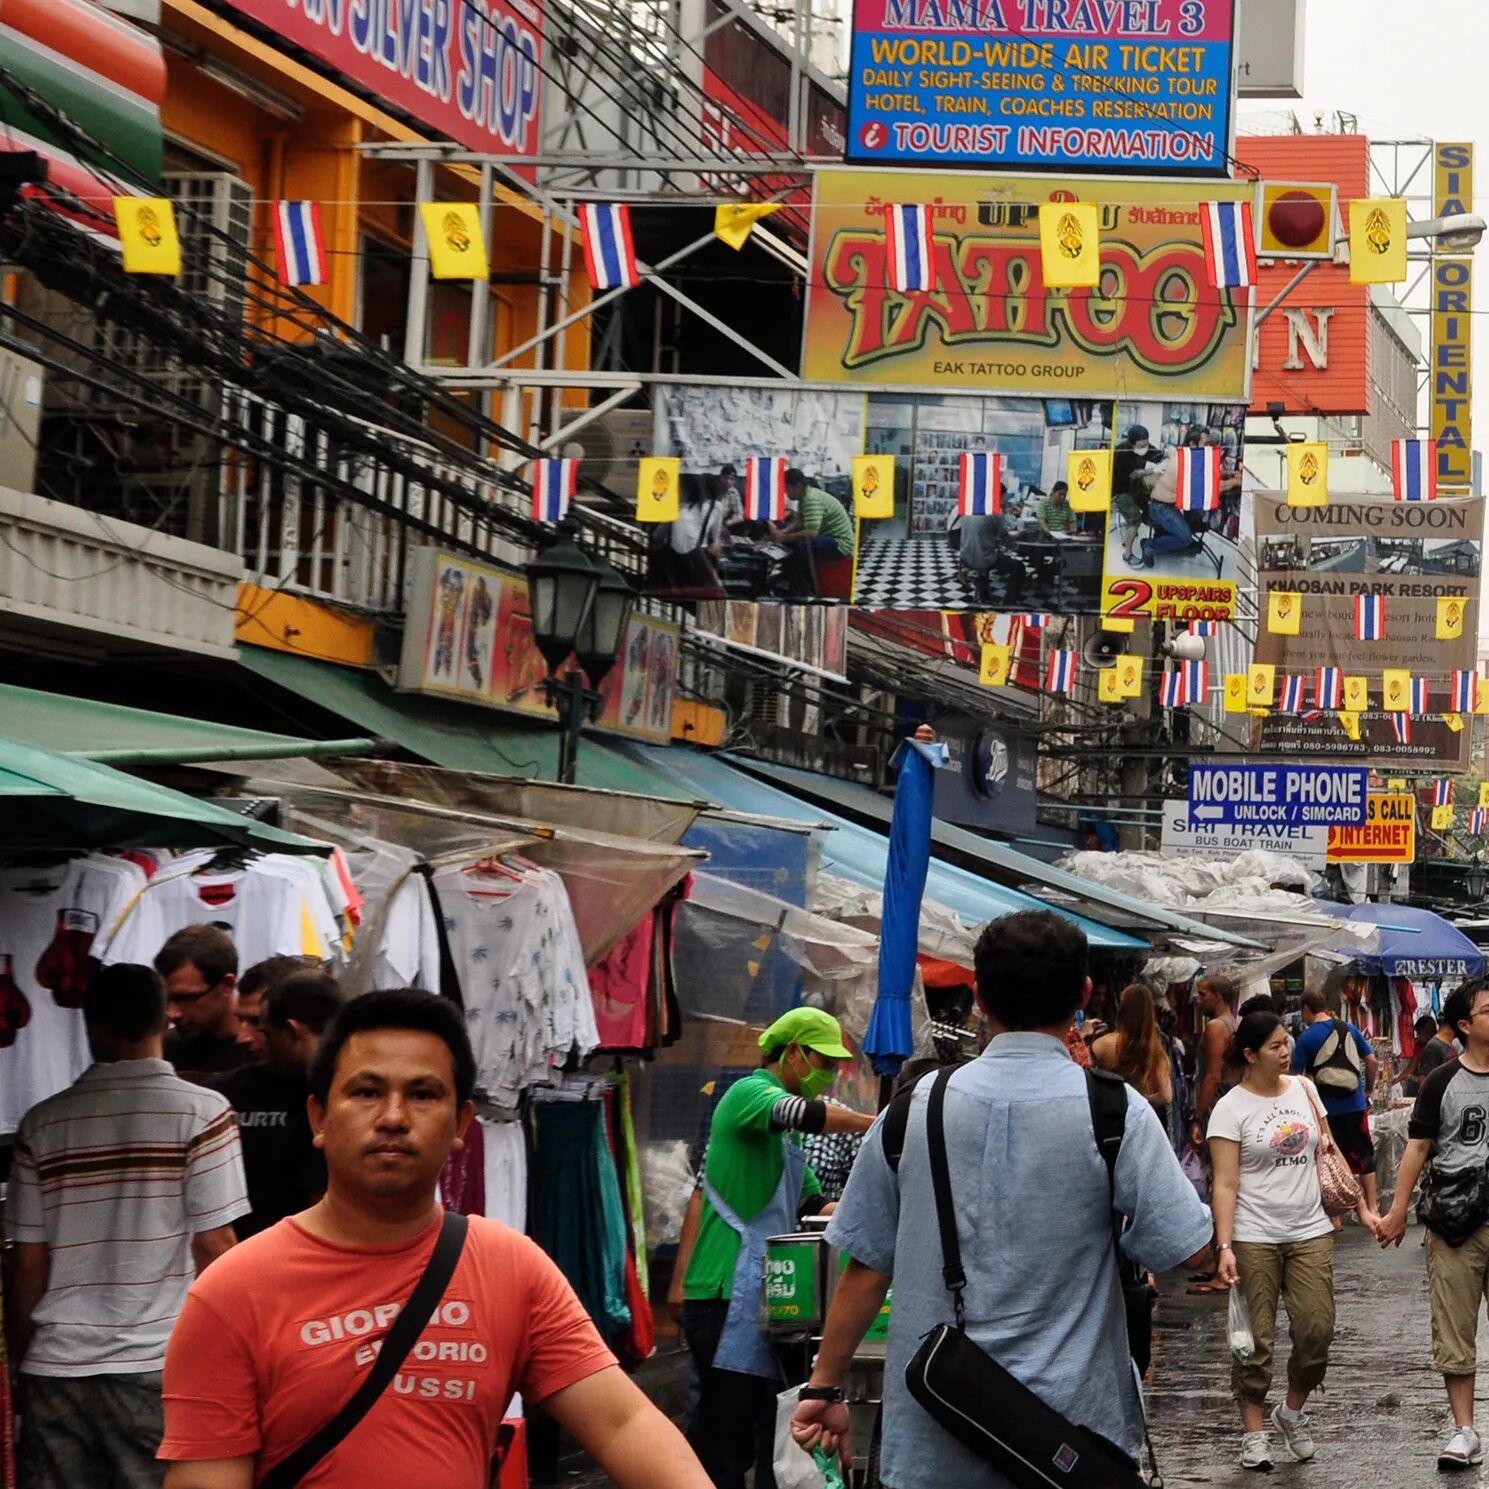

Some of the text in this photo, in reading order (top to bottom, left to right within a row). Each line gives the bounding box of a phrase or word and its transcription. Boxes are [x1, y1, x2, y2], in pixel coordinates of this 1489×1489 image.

[882, 0, 1205, 36] MAMA TRAVEL 3
[871, 37, 1206, 74] WORLD-WIDE AIR TICKET
[349, 0, 539, 153] SILVER SHOP
[862, 68, 1217, 96] DAILY SIGHT-SEEING & TREKKING TOUR
[865, 94, 1213, 121] HOTEL, TRAIN, COACHES RESERVATION
[894, 122, 1214, 161] TOURIST INFORMATION
[1437, 146, 1471, 249] SIA
[824, 228, 1236, 376] TATTOO
[933, 361, 1085, 380] EAK TATTOO GROUP
[1436, 263, 1470, 476] ORIENTAL
[1274, 503, 1468, 529] COMING SOON
[1107, 579, 1153, 618] 2
[1266, 580, 1468, 598] KHAOSAN PARK RESORT
[1156, 602, 1231, 622] FLOOR
[1414, 611, 1437, 624] hote
[1192, 770, 1362, 804] MOBILE PHONE
[1234, 805, 1361, 822] UNLOCK / SIMCARD
[1381, 800, 1412, 820] CALL
[1195, 836, 1293, 850] BUS BOAT TRAIN
[1229, 823, 1314, 840] TRAVEL
[1340, 825, 1411, 845] INTERNET
[1274, 1155, 1308, 1168] ELMO
